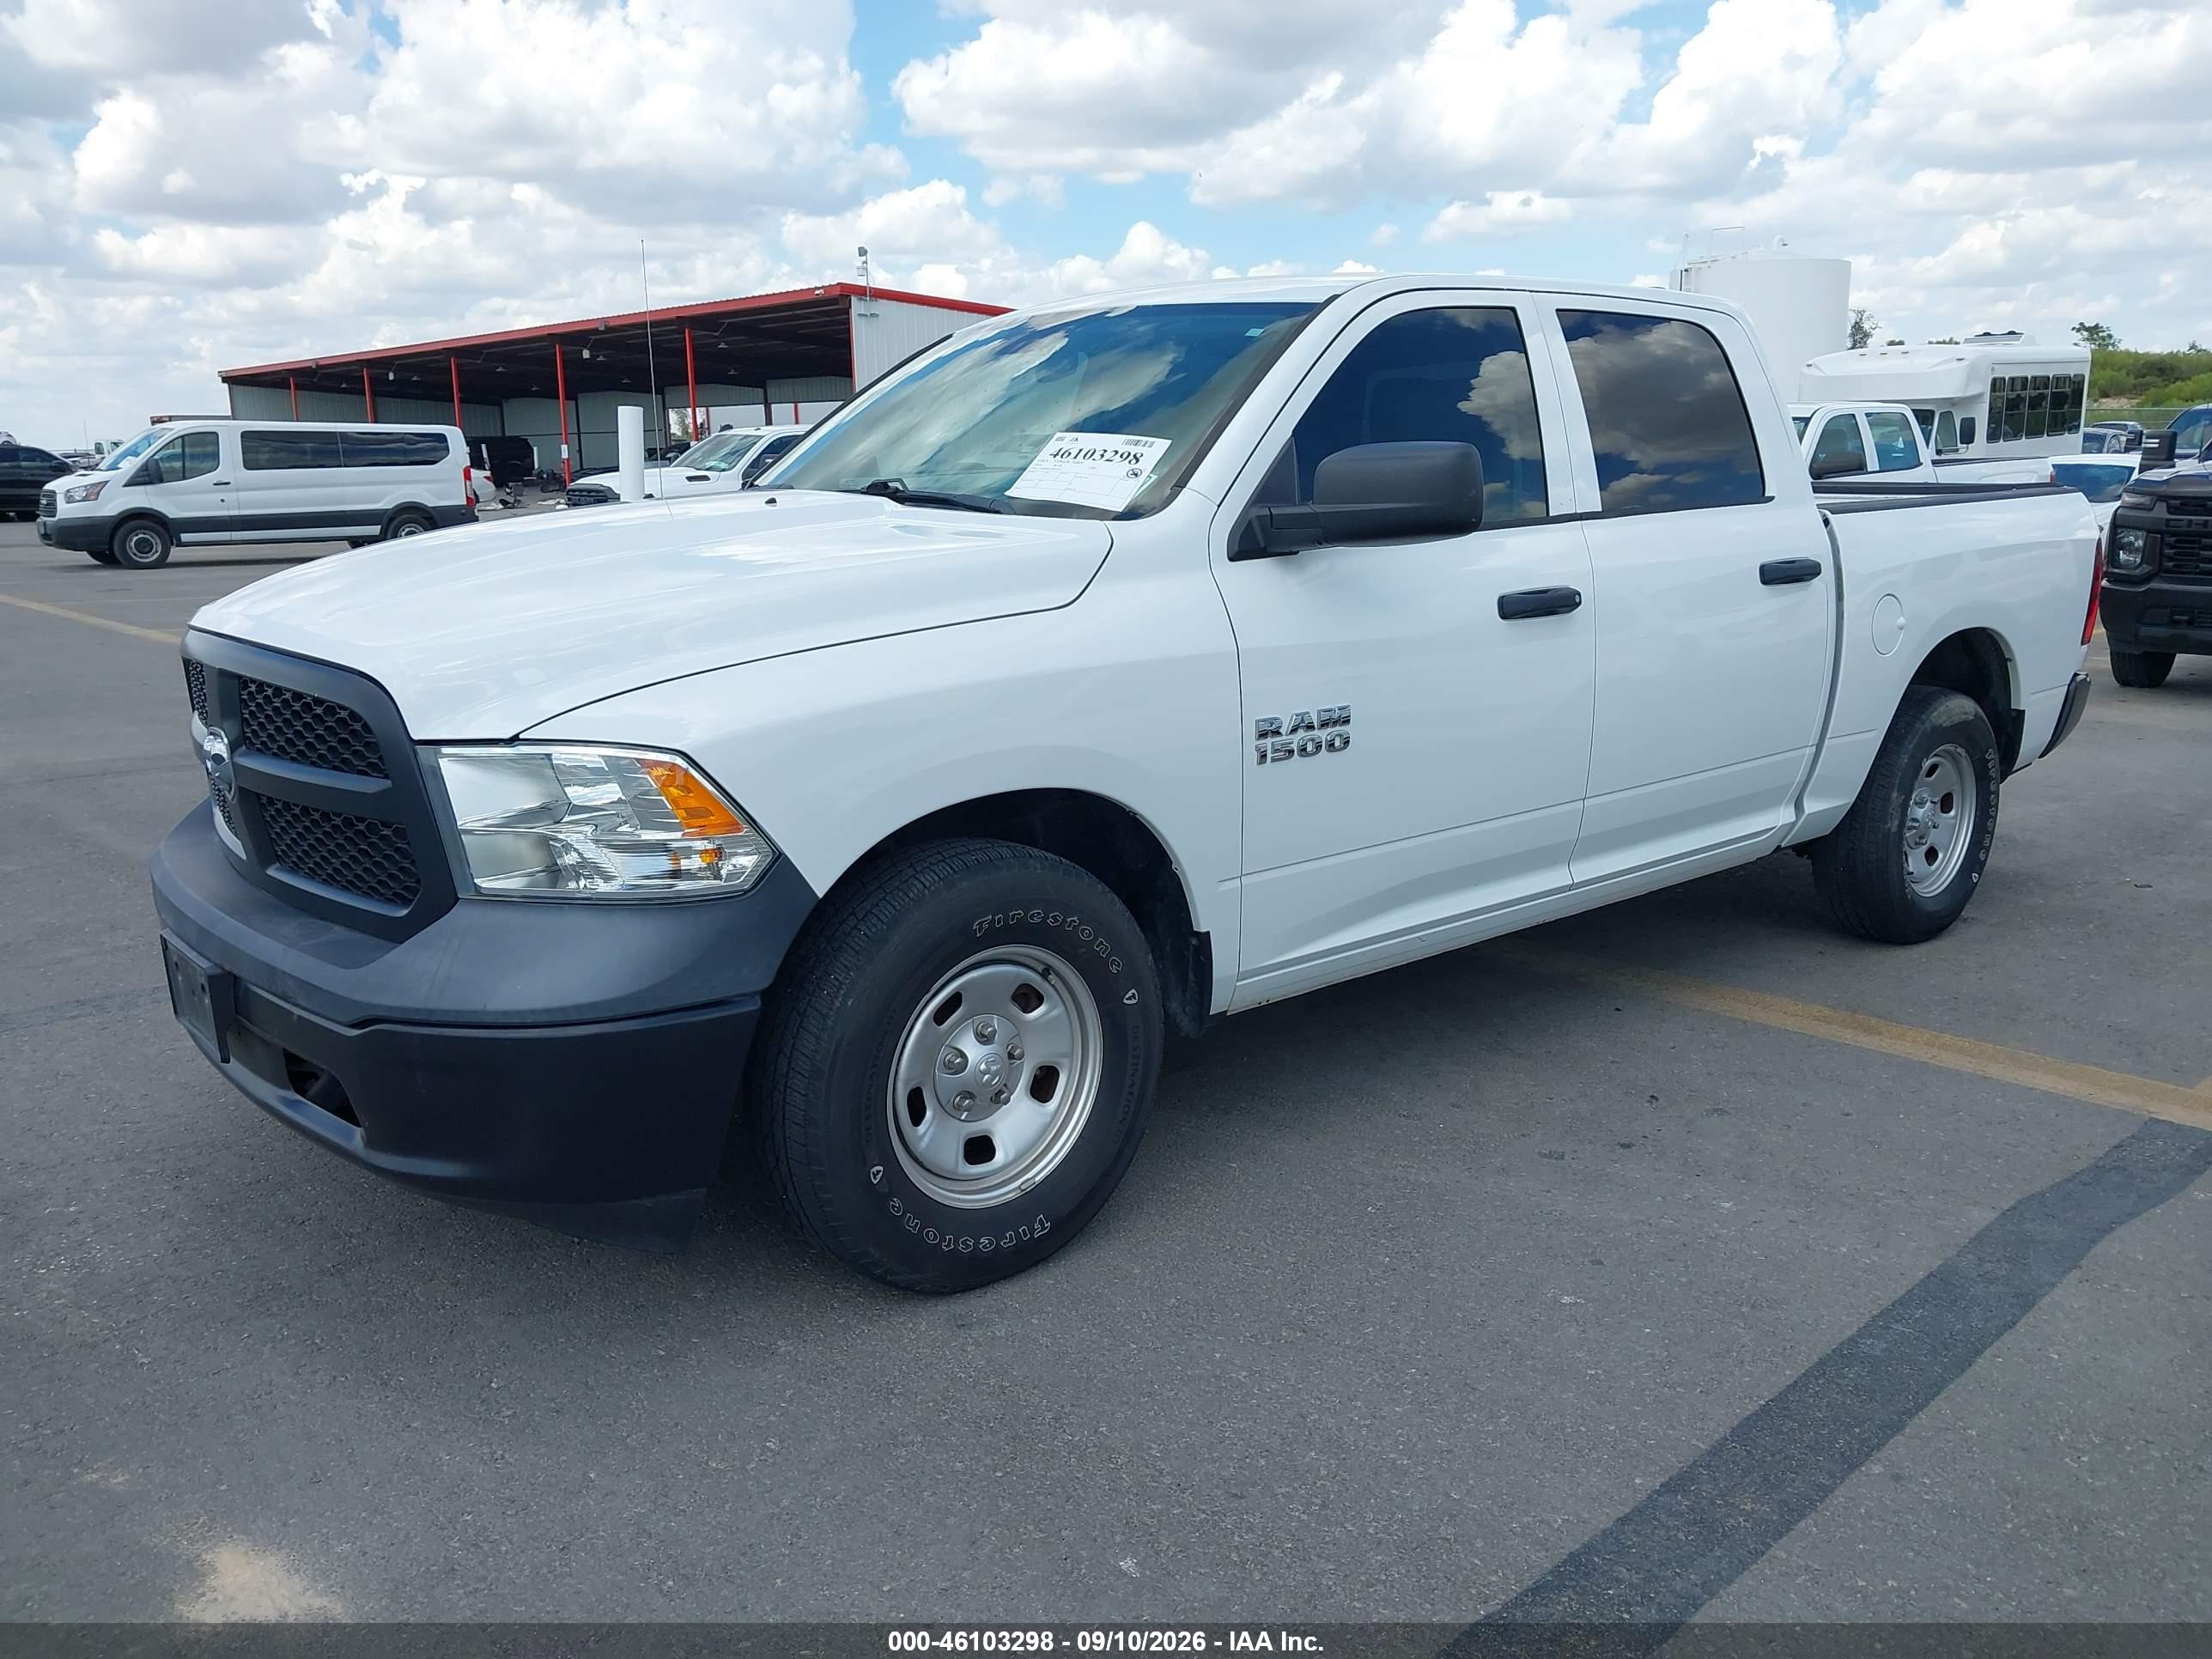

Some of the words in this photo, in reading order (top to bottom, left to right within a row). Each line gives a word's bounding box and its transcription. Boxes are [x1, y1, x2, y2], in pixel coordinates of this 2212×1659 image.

[1049, 447, 1144, 465] 46103298
[1255, 704, 1352, 741] RAM
[1255, 729, 1351, 766] 1500
[973, 909, 1122, 974] Firestone
[890, 1197, 1051, 1253] Firestone
